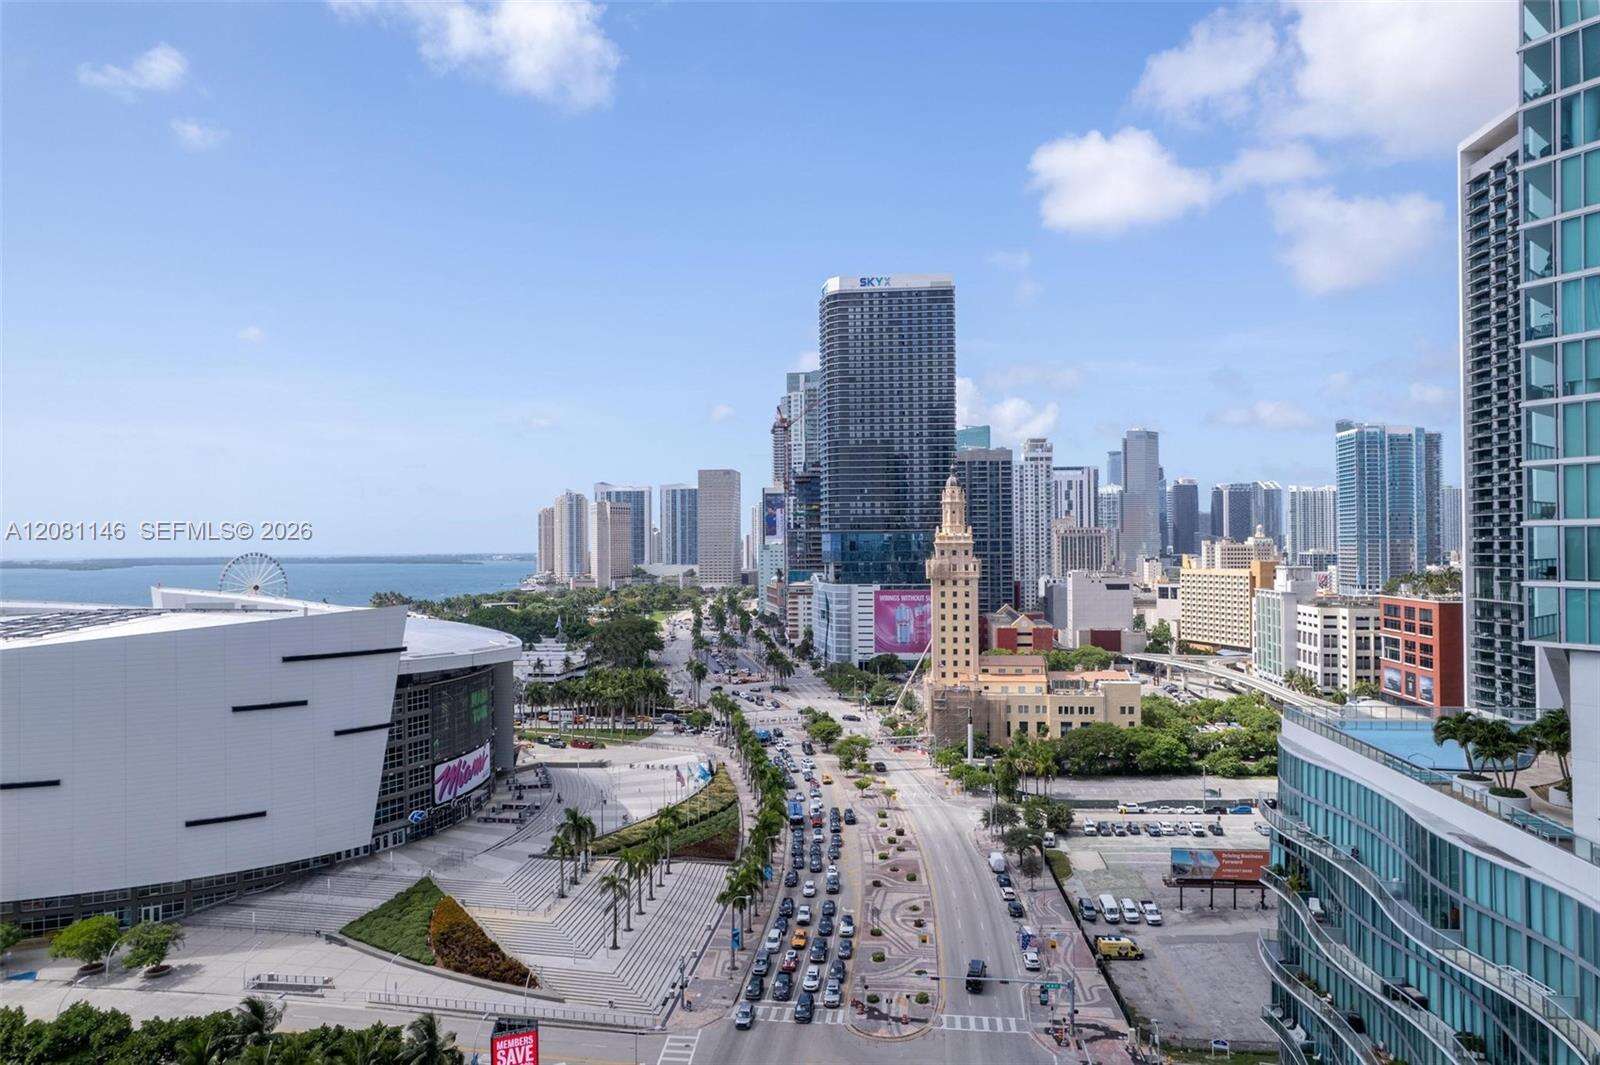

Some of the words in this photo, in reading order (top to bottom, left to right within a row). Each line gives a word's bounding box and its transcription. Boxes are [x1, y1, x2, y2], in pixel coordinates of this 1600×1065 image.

[859, 277, 891, 287] SKYX
[433, 751, 488, 802] Miami
[496, 1035, 534, 1051] MEMBERS
[496, 1045, 535, 1065] SAVE
